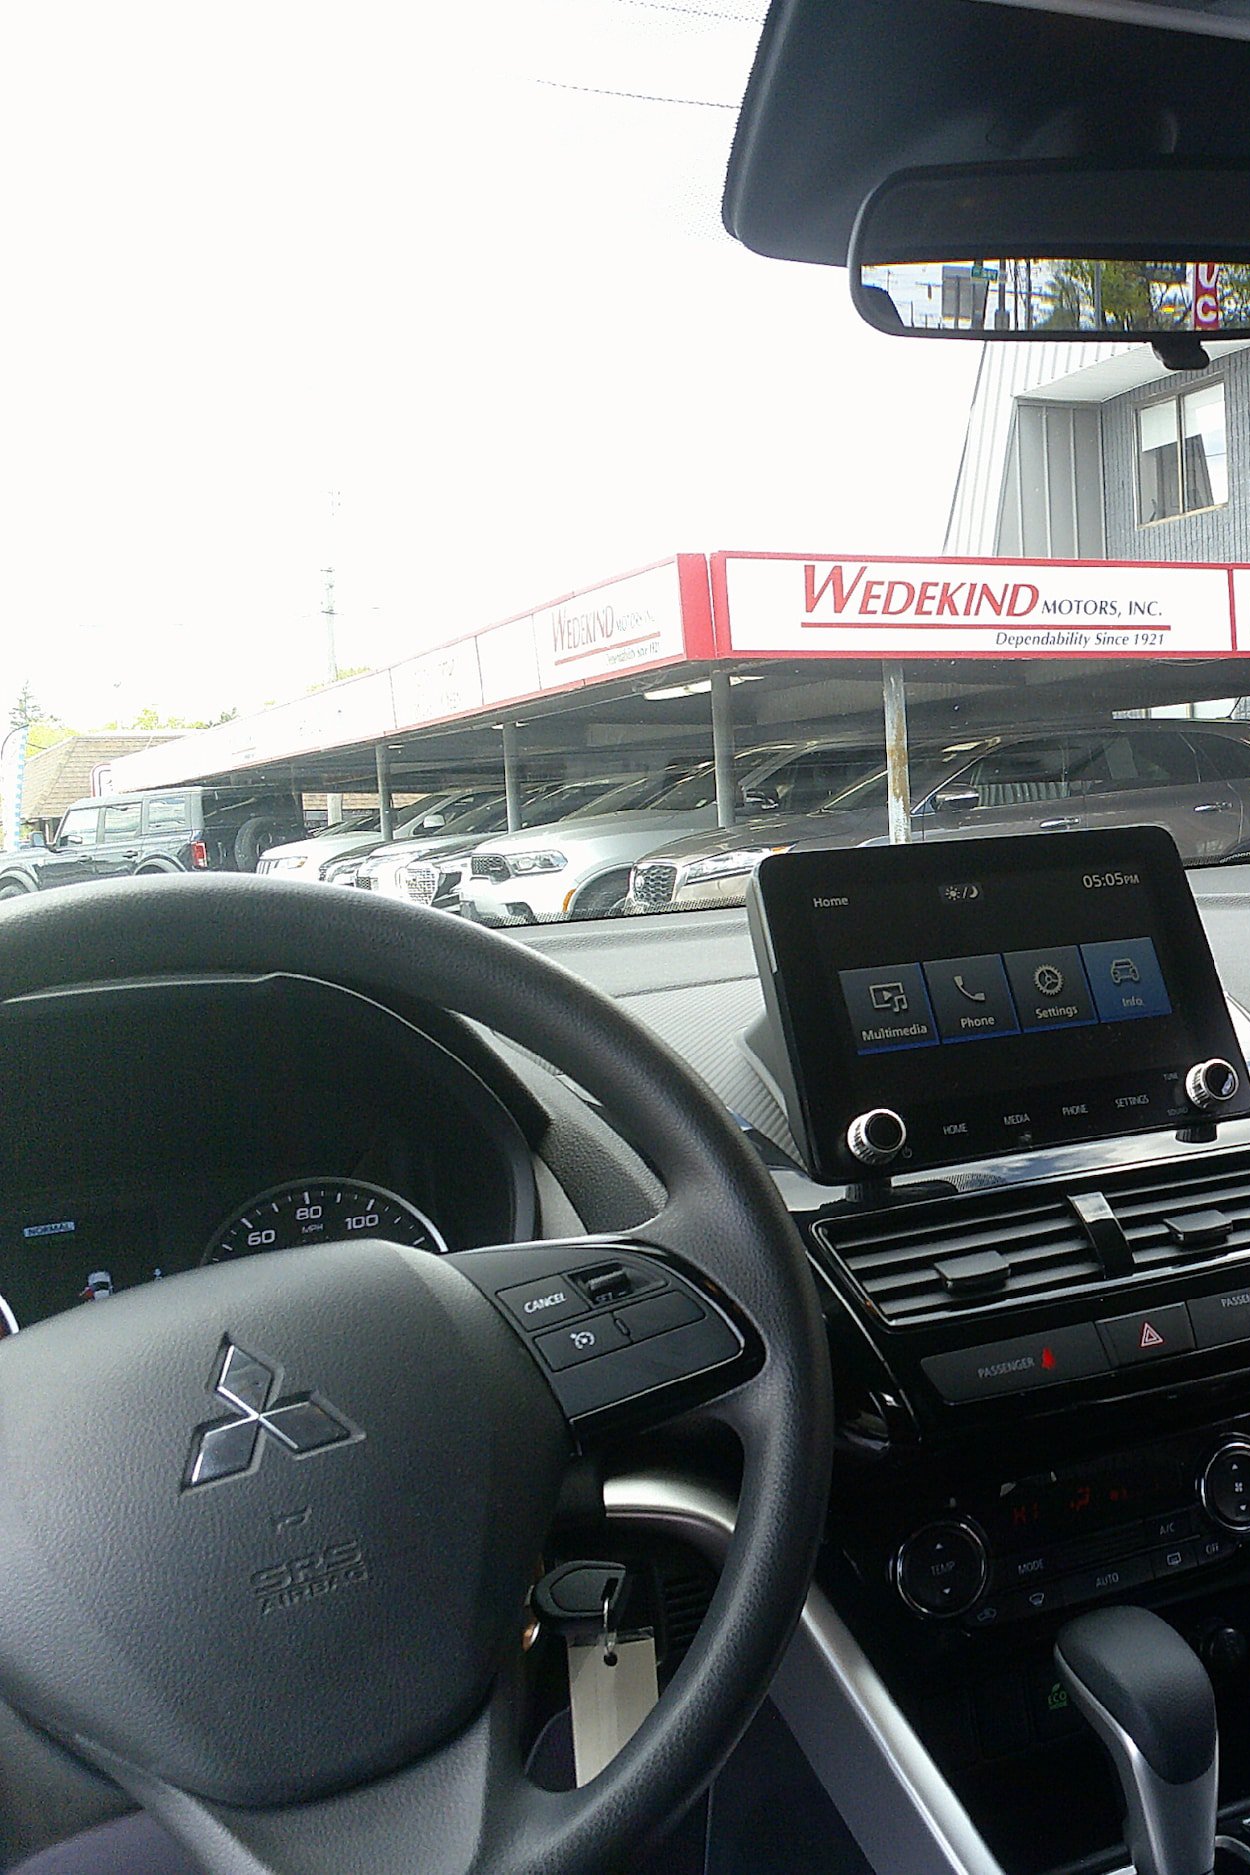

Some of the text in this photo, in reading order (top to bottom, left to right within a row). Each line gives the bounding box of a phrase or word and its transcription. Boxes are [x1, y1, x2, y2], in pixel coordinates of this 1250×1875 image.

[803, 564, 1163, 618] WEDEKIND MOTORS, INC.
[551, 605, 614, 653] WEDEKIND
[995, 631, 1165, 648] Dependability Since 1921
[813, 895, 849, 909] Home
[1122, 995, 1143, 1008] Info
[1035, 1003, 1078, 1020] Settings
[960, 1014, 995, 1029] Phone
[861, 1022, 929, 1042] Multimedia
[1114, 1093, 1150, 1110] SETTINGS
[1062, 1103, 1089, 1118] PHONE
[1003, 1112, 1031, 1127] MEDIA
[942, 1121, 968, 1136] HOME
[295, 1204, 323, 1221] 80
[301, 1223, 324, 1235] MPH
[344, 1213, 380, 1231] 100
[248, 1229, 277, 1247] 60
[523, 1291, 567, 1314] CANCEL
[977, 1356, 1035, 1379] PASSENGER
[1159, 1521, 1176, 1536] A/C
[1205, 1541, 1220, 1556] OFF
[250, 1540, 363, 1597] SRS
[930, 1560, 956, 1577] TEMP
[1018, 1558, 1046, 1575] MODE
[1096, 1572, 1119, 1588] AUTO
